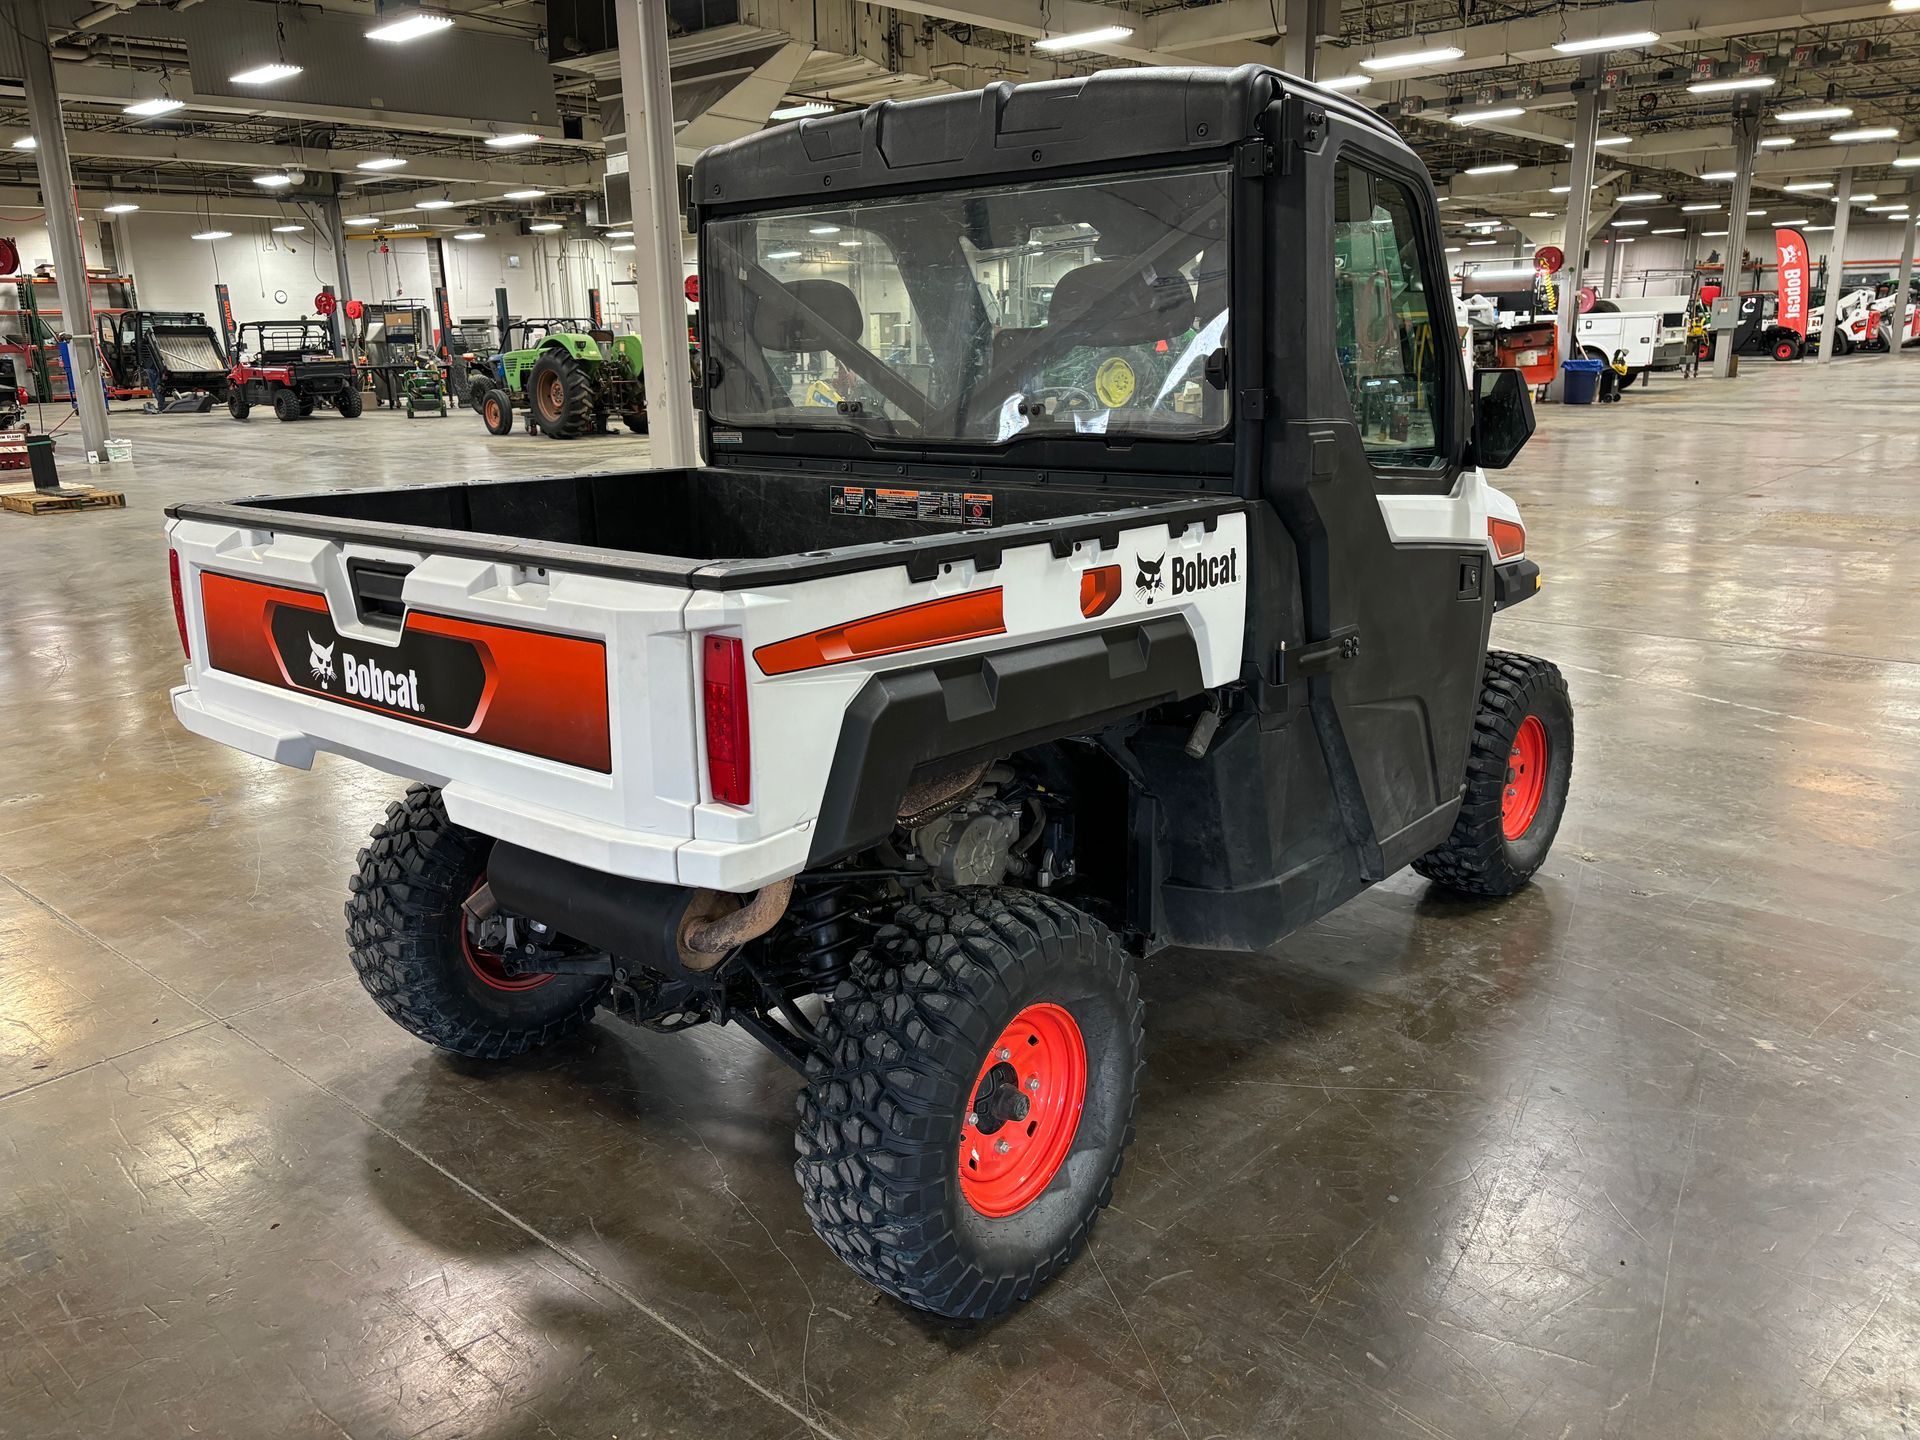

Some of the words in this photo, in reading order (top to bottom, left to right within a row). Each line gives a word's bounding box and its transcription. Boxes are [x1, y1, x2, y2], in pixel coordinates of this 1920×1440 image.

[223, 300, 235, 332] STRATUS
[1784, 268, 1801, 318] Bobcat
[1172, 547, 1237, 596] Bobcat
[342, 653, 421, 712] Bobcat
